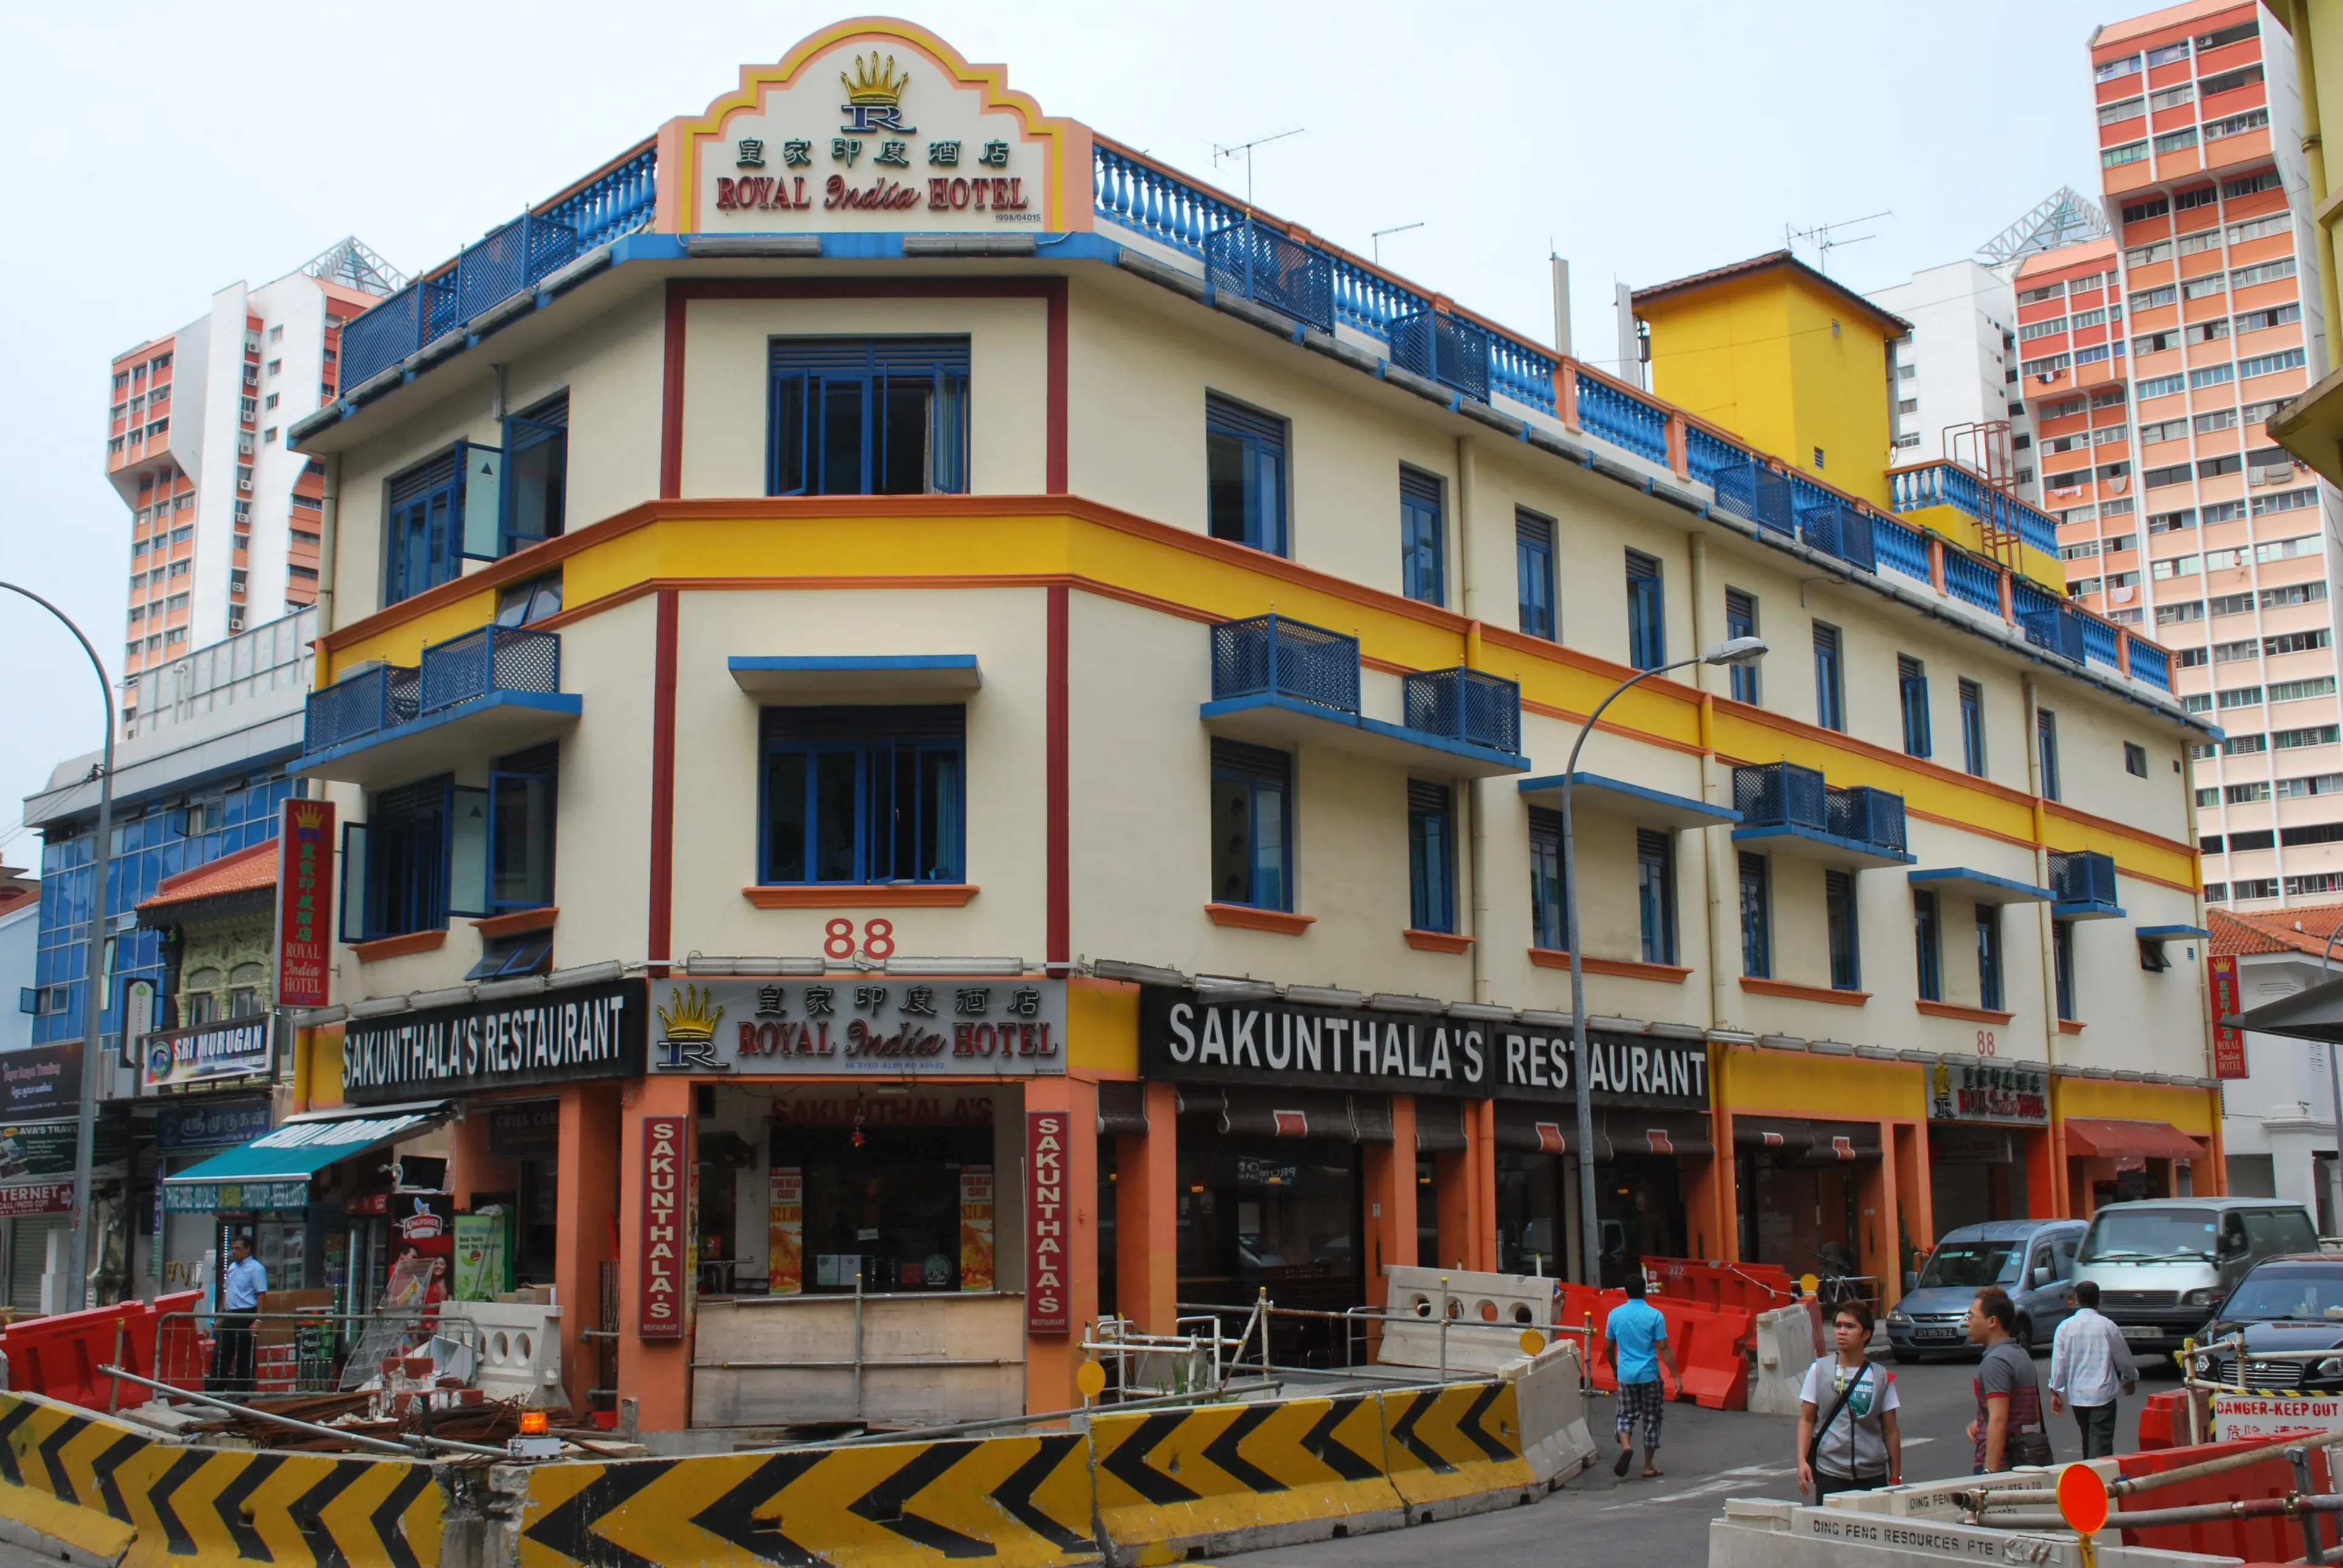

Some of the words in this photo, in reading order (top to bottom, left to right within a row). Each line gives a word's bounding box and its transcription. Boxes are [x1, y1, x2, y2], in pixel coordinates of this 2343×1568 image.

[841, 105, 917, 133] R
[736, 137, 1010, 168] 皇家印度酒店
[716, 176, 811, 210] ROYAL
[824, 174, 922, 210] India
[928, 177, 1028, 210] HOTEL
[286, 942, 321, 959] ROYAL
[824, 918, 895, 959] 88
[284, 959, 320, 976] India
[284, 976, 321, 993] HOTEL
[755, 985, 1041, 1017] 皇家印度酒店
[174, 1036, 195, 1060] SRI
[197, 1025, 263, 1058] MURUGAN
[342, 1016, 478, 1089] SAKUNTHALA'S
[485, 996, 623, 1073] RESTAURANT
[737, 1021, 836, 1057] ROYAL
[844, 1019, 946, 1057] India
[952, 1021, 1058, 1057] HOTEL
[1170, 1003, 1484, 1082] SAKUNTHALA'S
[1506, 1034, 1706, 1096] RESAURANT
[1977, 1030, 1995, 1056] 88
[2217, 1040, 2240, 1051] ROYAL
[656, 1040, 730, 1069] R
[2218, 1062, 2242, 1071] HOTEL
[771, 1097, 994, 1127] SAKUNTHALA'S
[48, 1125, 78, 1134] TRAVE
[0, 1186, 59, 1201] TERNET
[406, 1218, 439, 1230] KINGFISHER
[649, 1123, 676, 1318] SAKUNTHALA'S
[1037, 1119, 1061, 1313] SAKUNTHALA'S
[2217, 1401, 2309, 1416] DANGER-KEEP
[2312, 1403, 2339, 1417] OUT
[1910, 1497, 1929, 1510] DING
[1933, 1492, 1953, 1506] FEN
[1814, 1520, 1839, 1535] DING
[1846, 1524, 1877, 1540] FENG
[1884, 1530, 1959, 1550] RESOURCES
[1967, 1541, 1994, 1556] PTE
